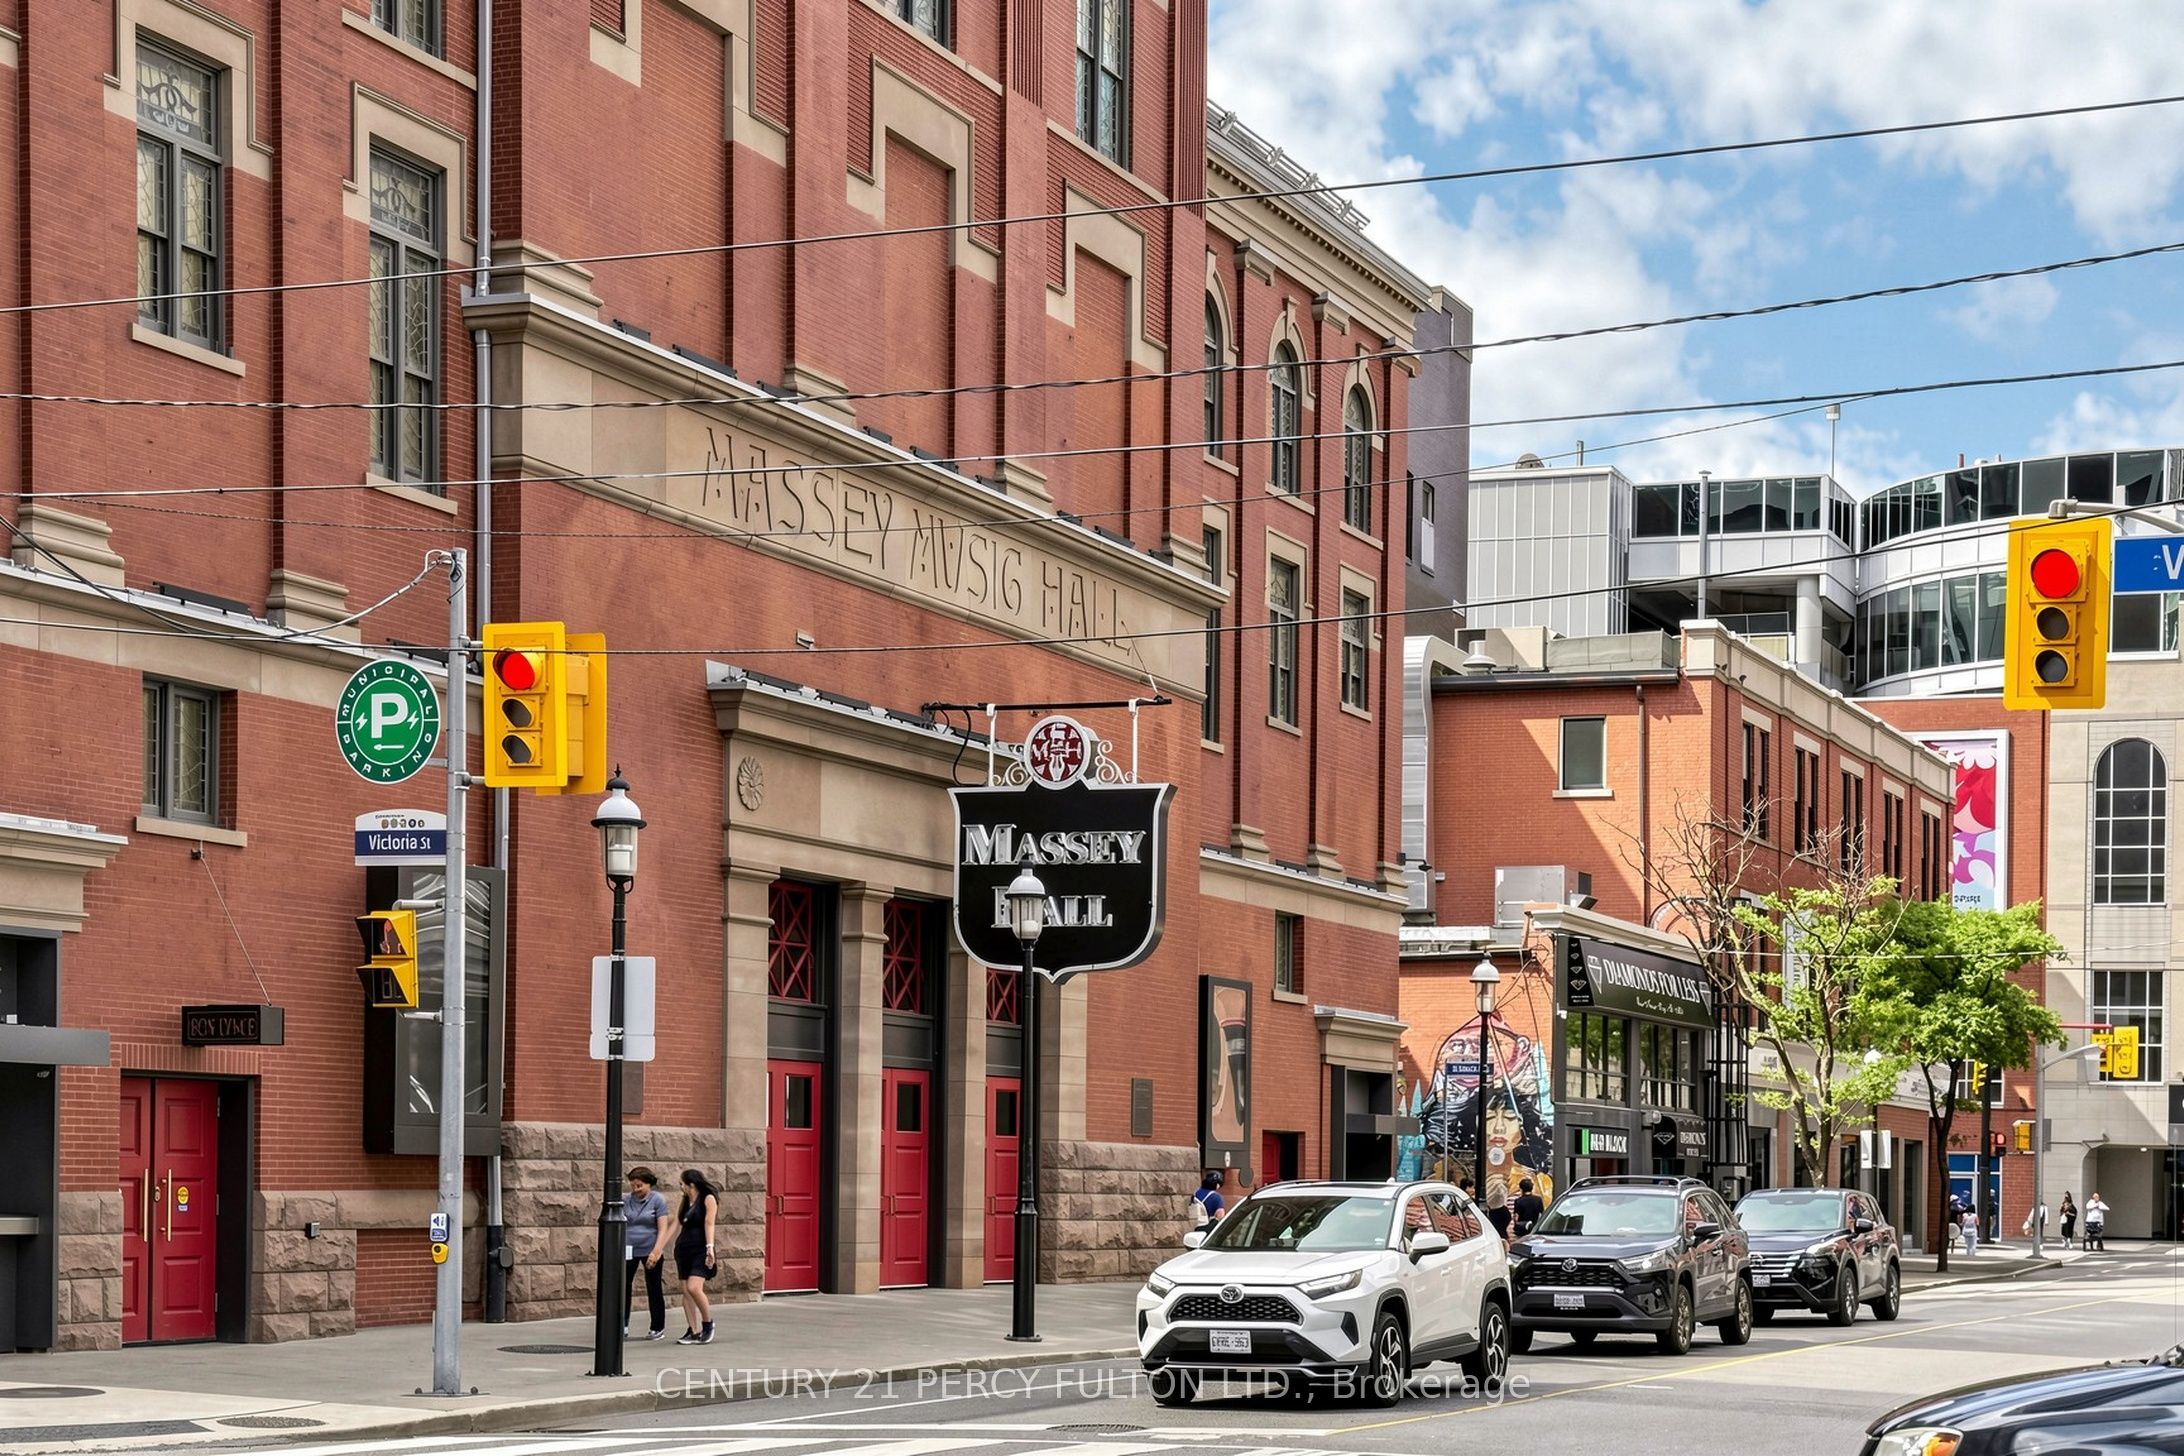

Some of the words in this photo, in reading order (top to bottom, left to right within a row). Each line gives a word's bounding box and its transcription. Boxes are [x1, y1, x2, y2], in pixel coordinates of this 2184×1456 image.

[702, 427, 893, 570] MASSEY
[1042, 560, 1132, 656] HALL
[342, 666, 433, 717] MUNICIPAL
[371, 692, 409, 739] P
[343, 733, 432, 778] PARKING
[368, 833, 417, 850] Victoria
[420, 836, 431, 850] St
[961, 823, 1147, 865] MASSEY
